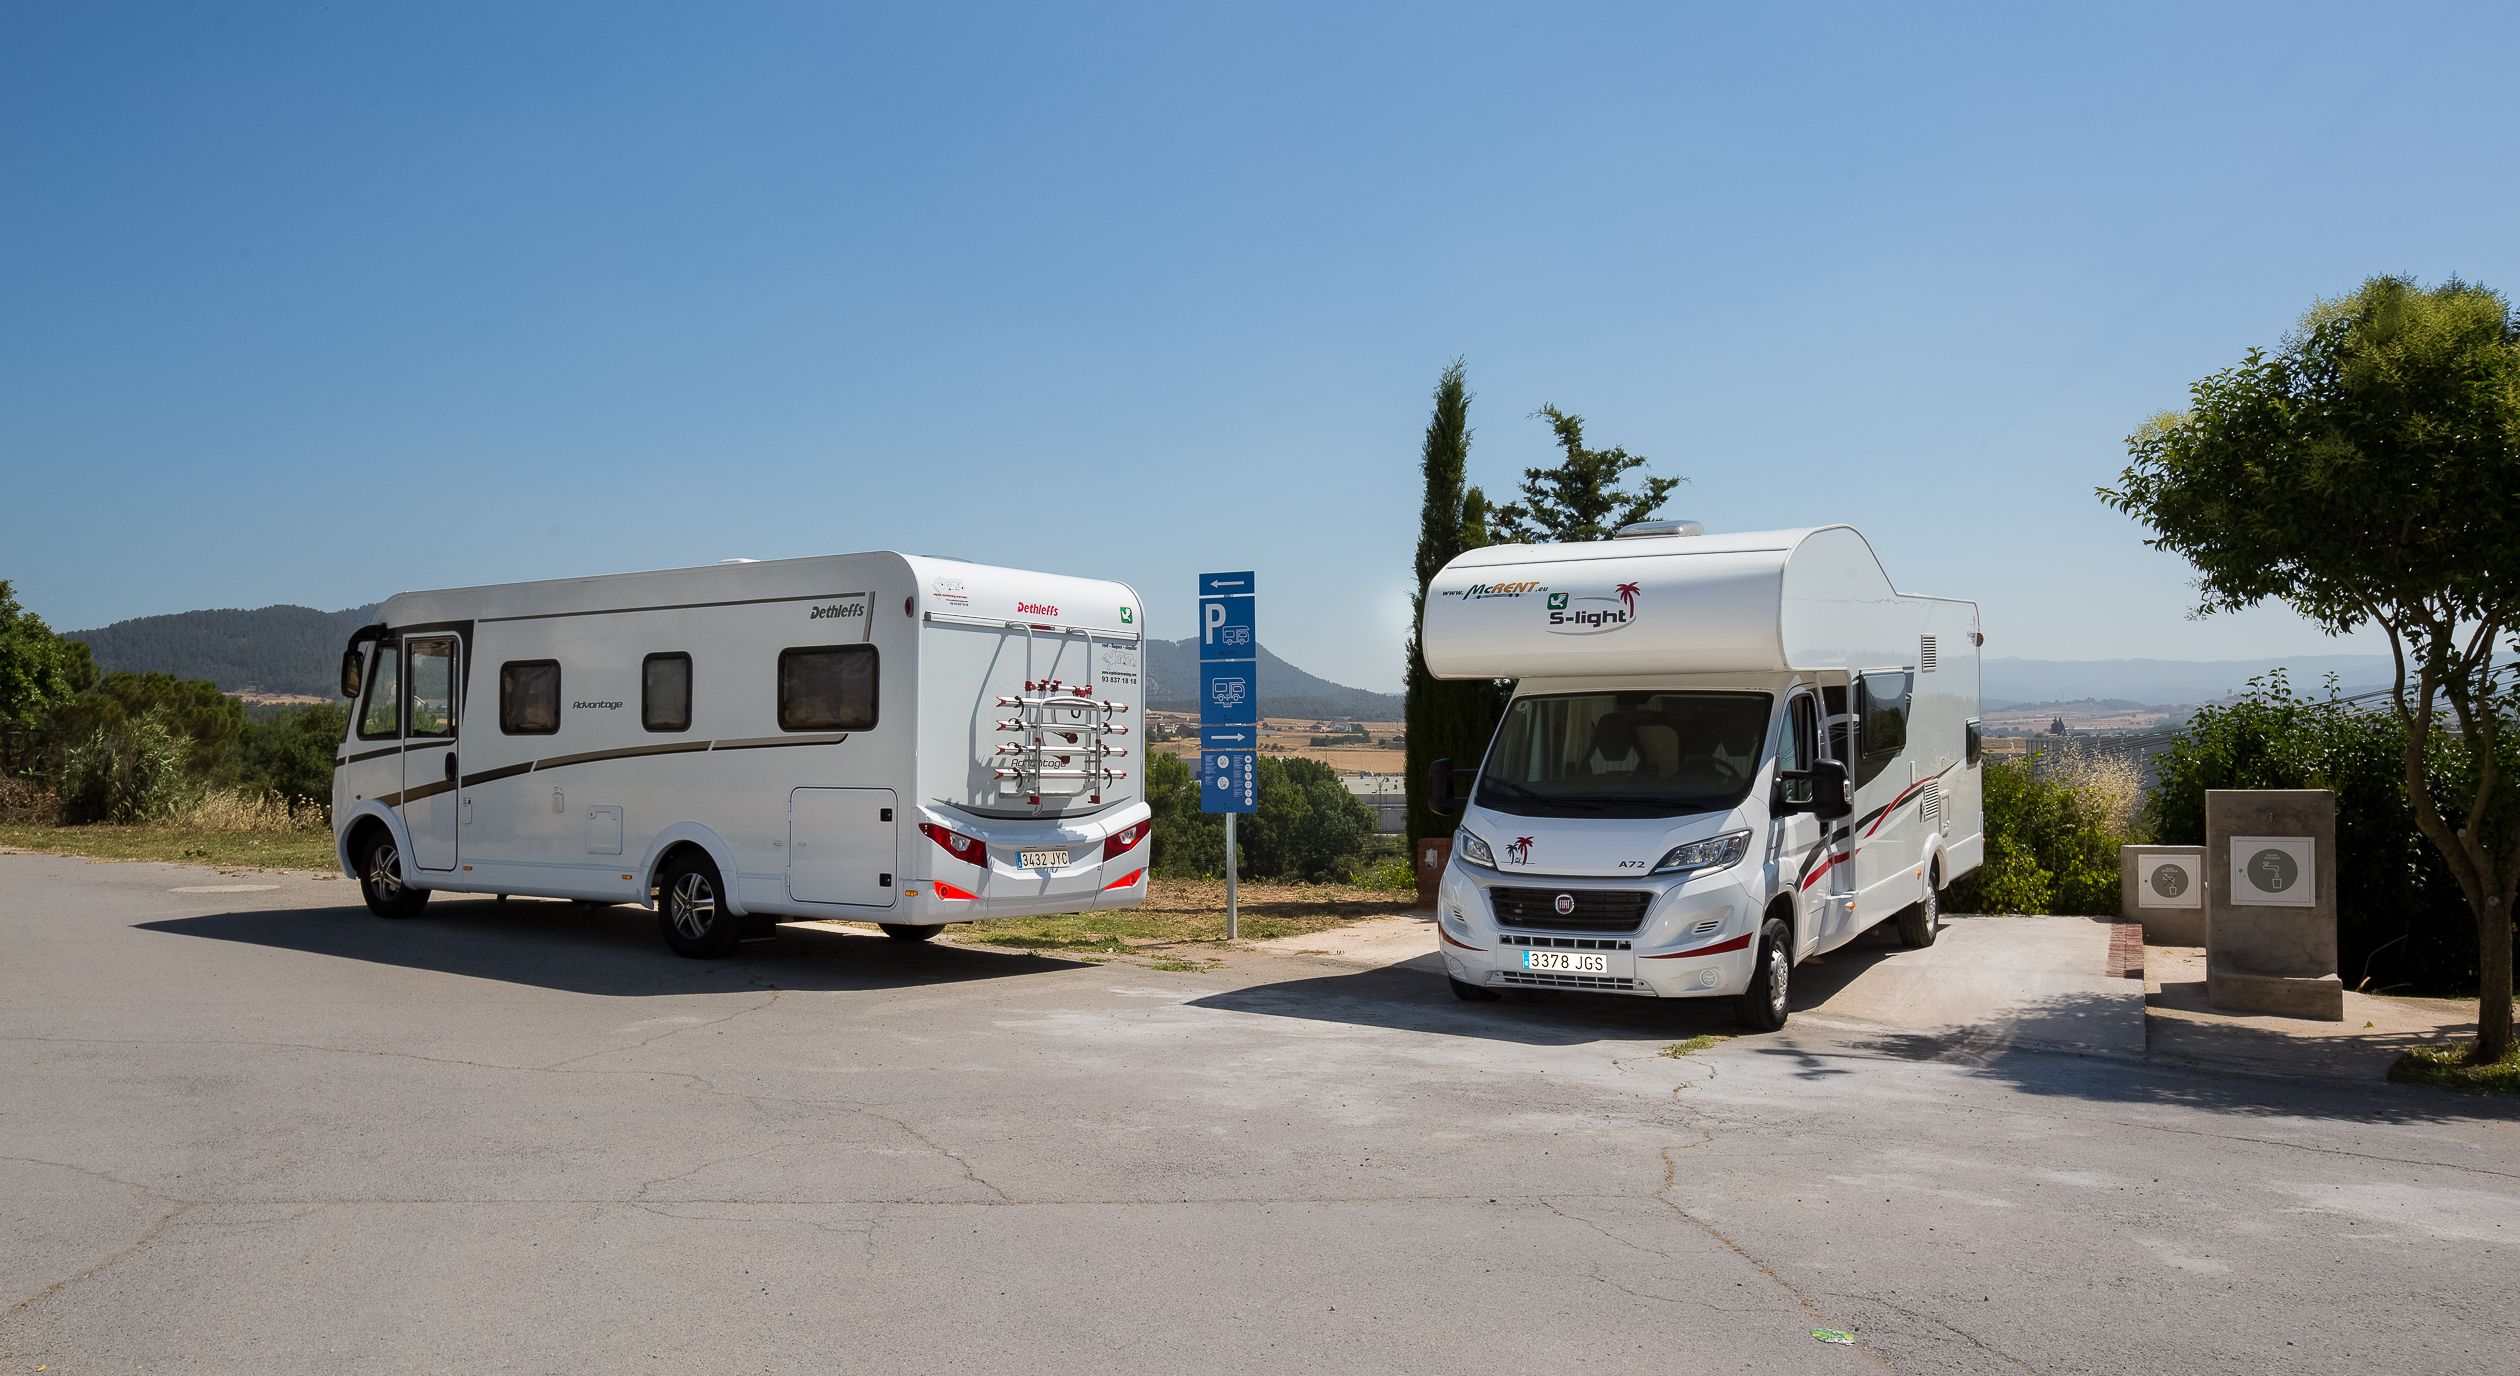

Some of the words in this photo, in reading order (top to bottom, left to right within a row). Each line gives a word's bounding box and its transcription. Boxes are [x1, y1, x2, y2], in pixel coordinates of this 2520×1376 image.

[810, 603, 865, 619] Dethleffs
[1017, 601, 1059, 616] Dethleffs
[1205, 603, 1227, 645] P
[1549, 609, 1627, 627] S-light
[572, 700, 623, 710] Advantage
[1022, 853, 1048, 867] 3432
[1050, 852, 1068, 865] JYC
[1618, 860, 1646, 869] A72
[1531, 953, 1570, 969] 3378
[1575, 956, 1604, 971] JGS
